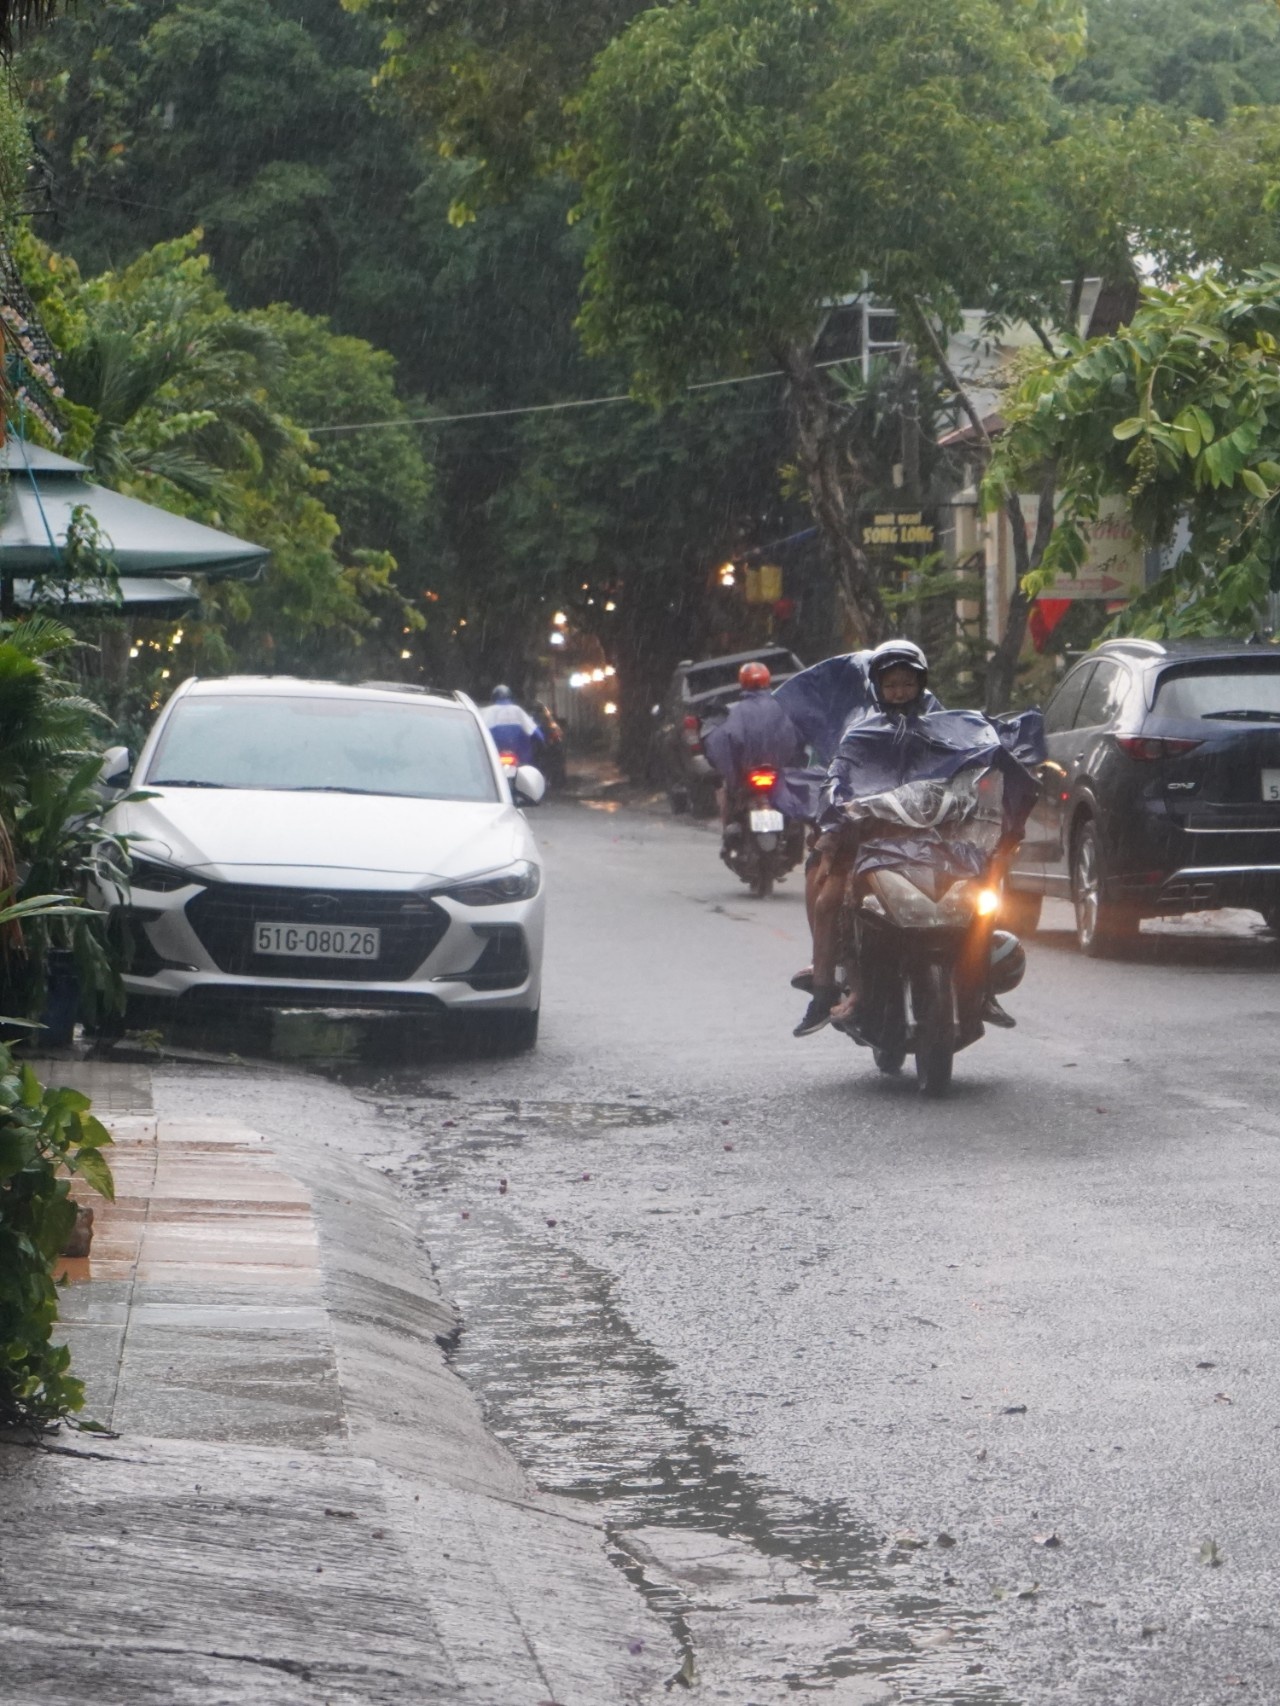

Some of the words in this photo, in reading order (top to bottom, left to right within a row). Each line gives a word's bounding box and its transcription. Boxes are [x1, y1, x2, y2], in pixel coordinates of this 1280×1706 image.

[863, 526, 898, 544] SONG
[900, 525, 934, 543] LONG
[258, 927, 375, 955] 51G-080.26
